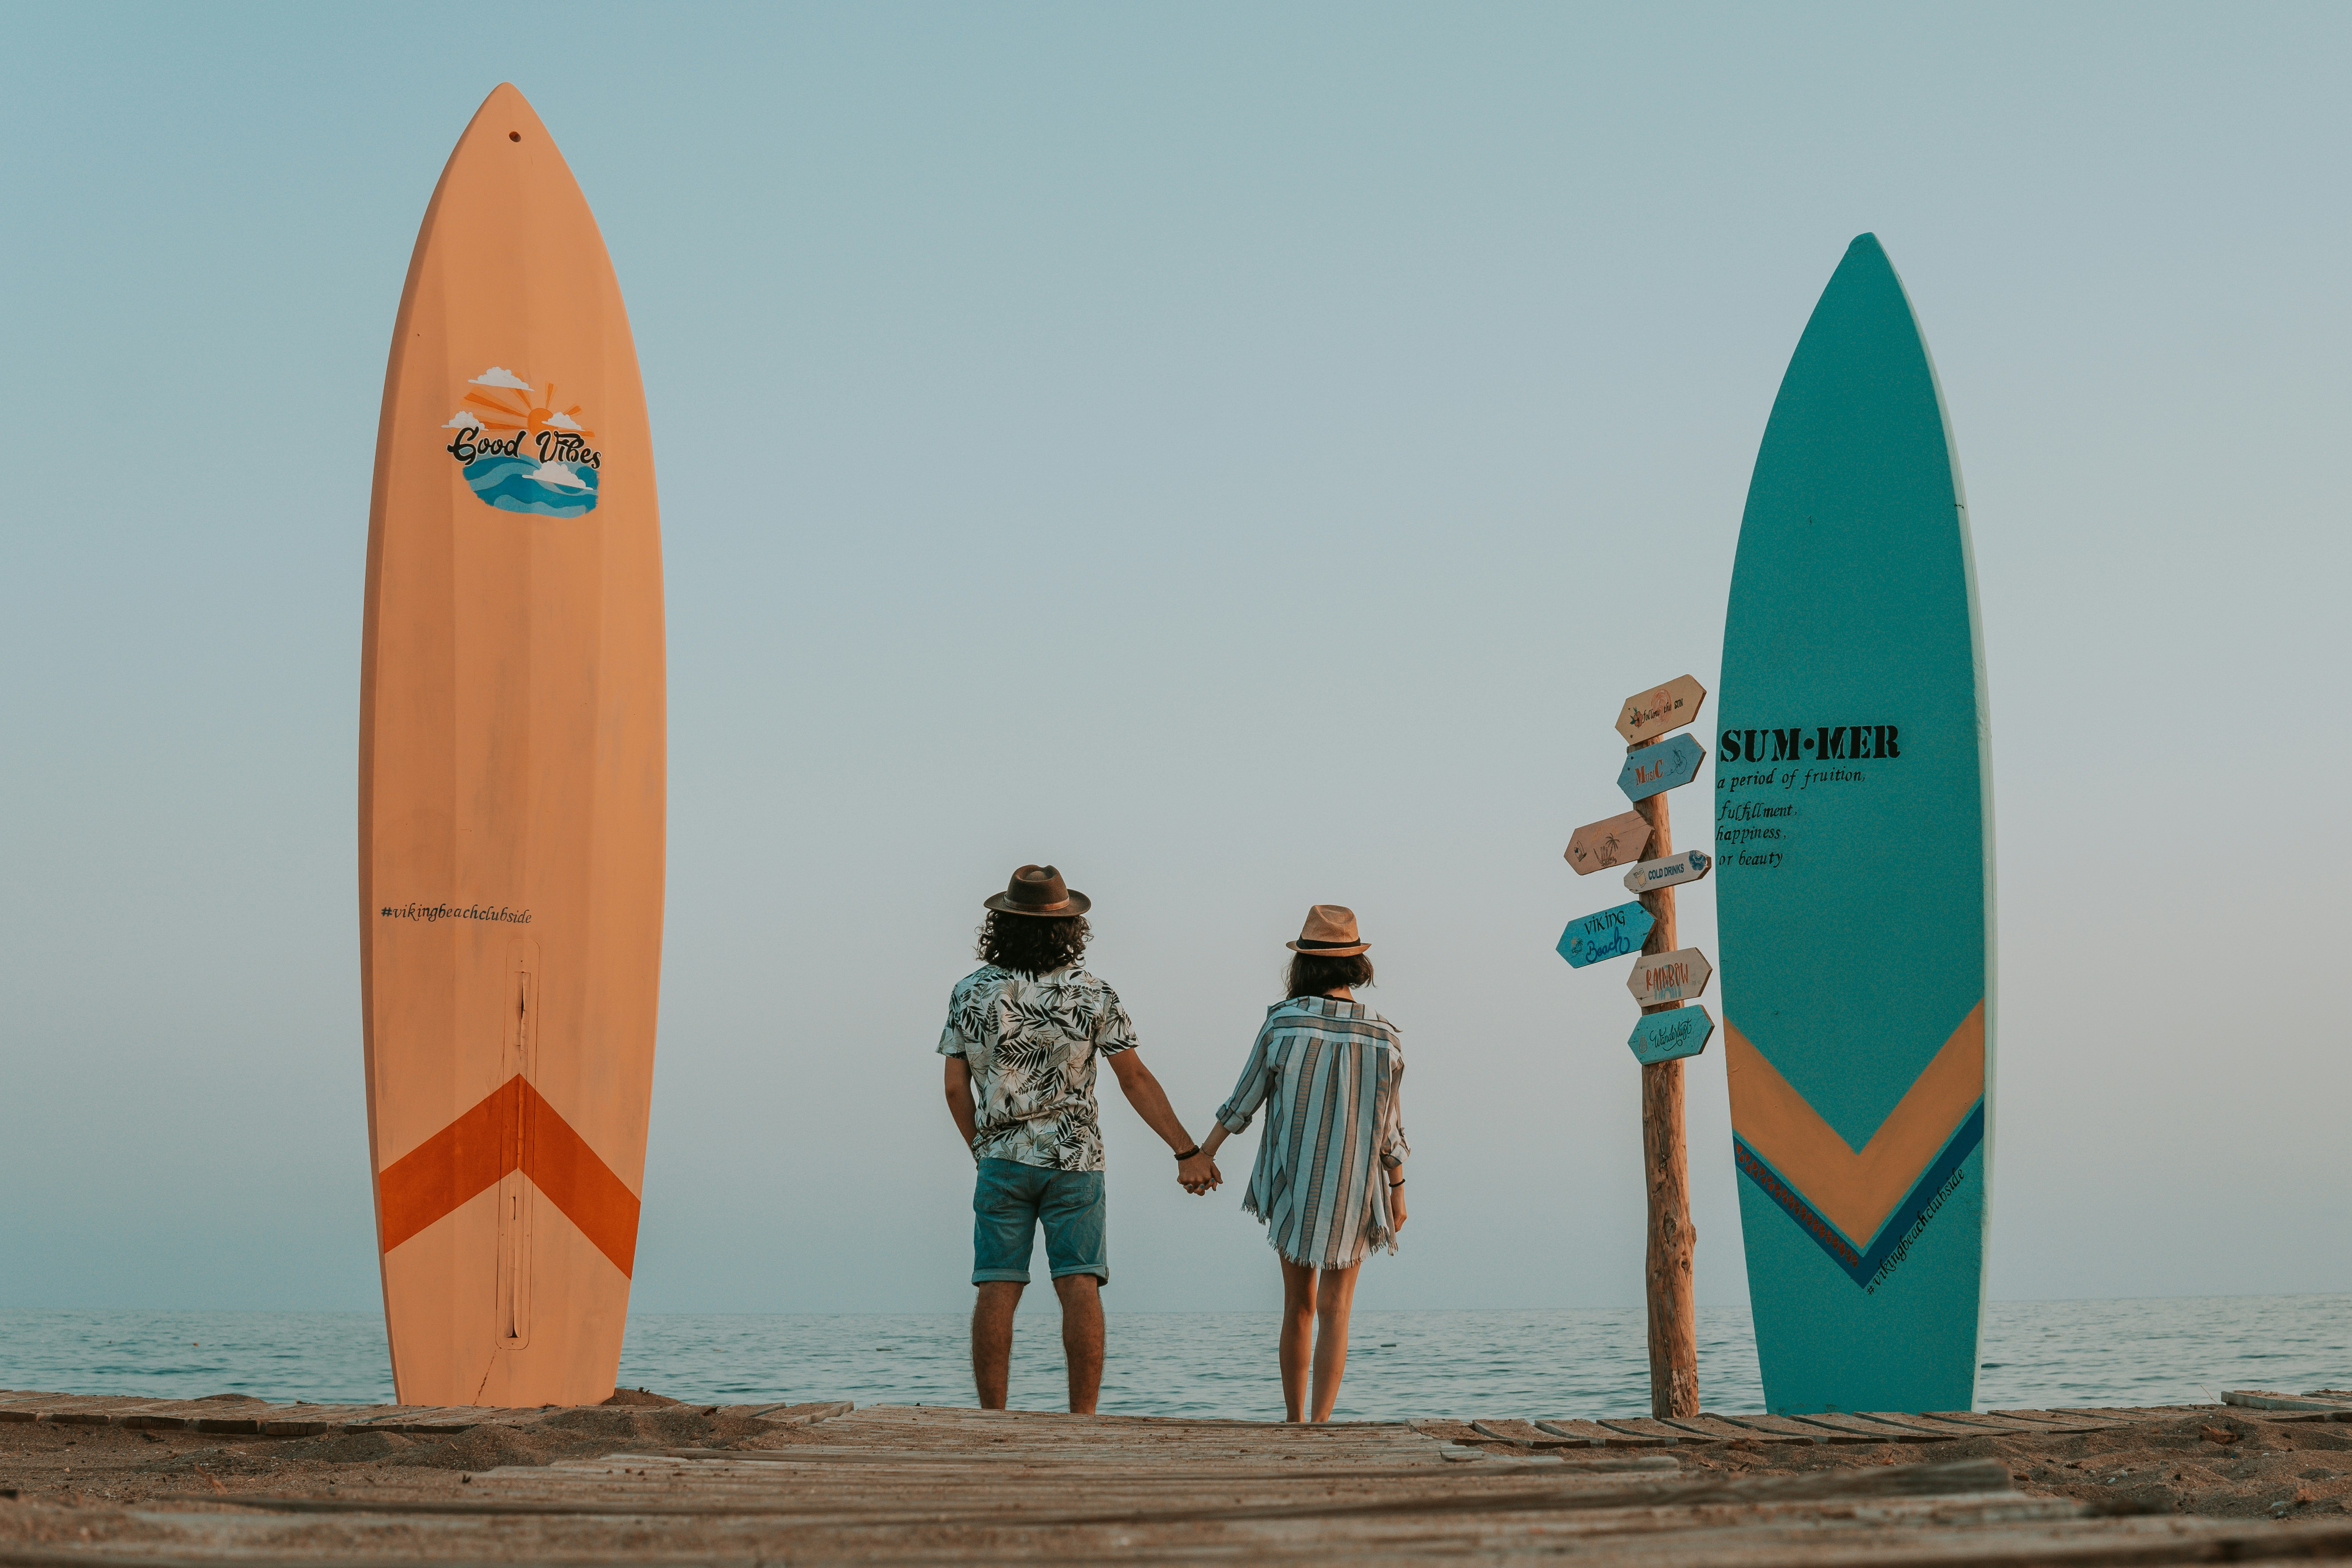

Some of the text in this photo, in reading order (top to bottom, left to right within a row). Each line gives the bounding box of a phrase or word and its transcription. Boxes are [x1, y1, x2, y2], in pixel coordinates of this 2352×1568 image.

[447, 426, 601, 469] Good Vibes
[1643, 698, 1683, 724] follow the SUN
[1717, 766, 1866, 792] a period of fruition,
[1717, 800, 1798, 821] fulfillment,
[1715, 825, 1787, 844] happiness,
[1648, 863, 1684, 881] COLD DRINKS
[1719, 850, 1783, 868] or beauty
[381, 903, 532, 924] #vikingbeachclubside
[1586, 927, 1630, 963] Beach
[1646, 962, 1688, 991] RAINBOW
[1649, 1017, 1692, 1051] Wanderlust
[1866, 1167, 1965, 1296] #vikingbeachclubside
